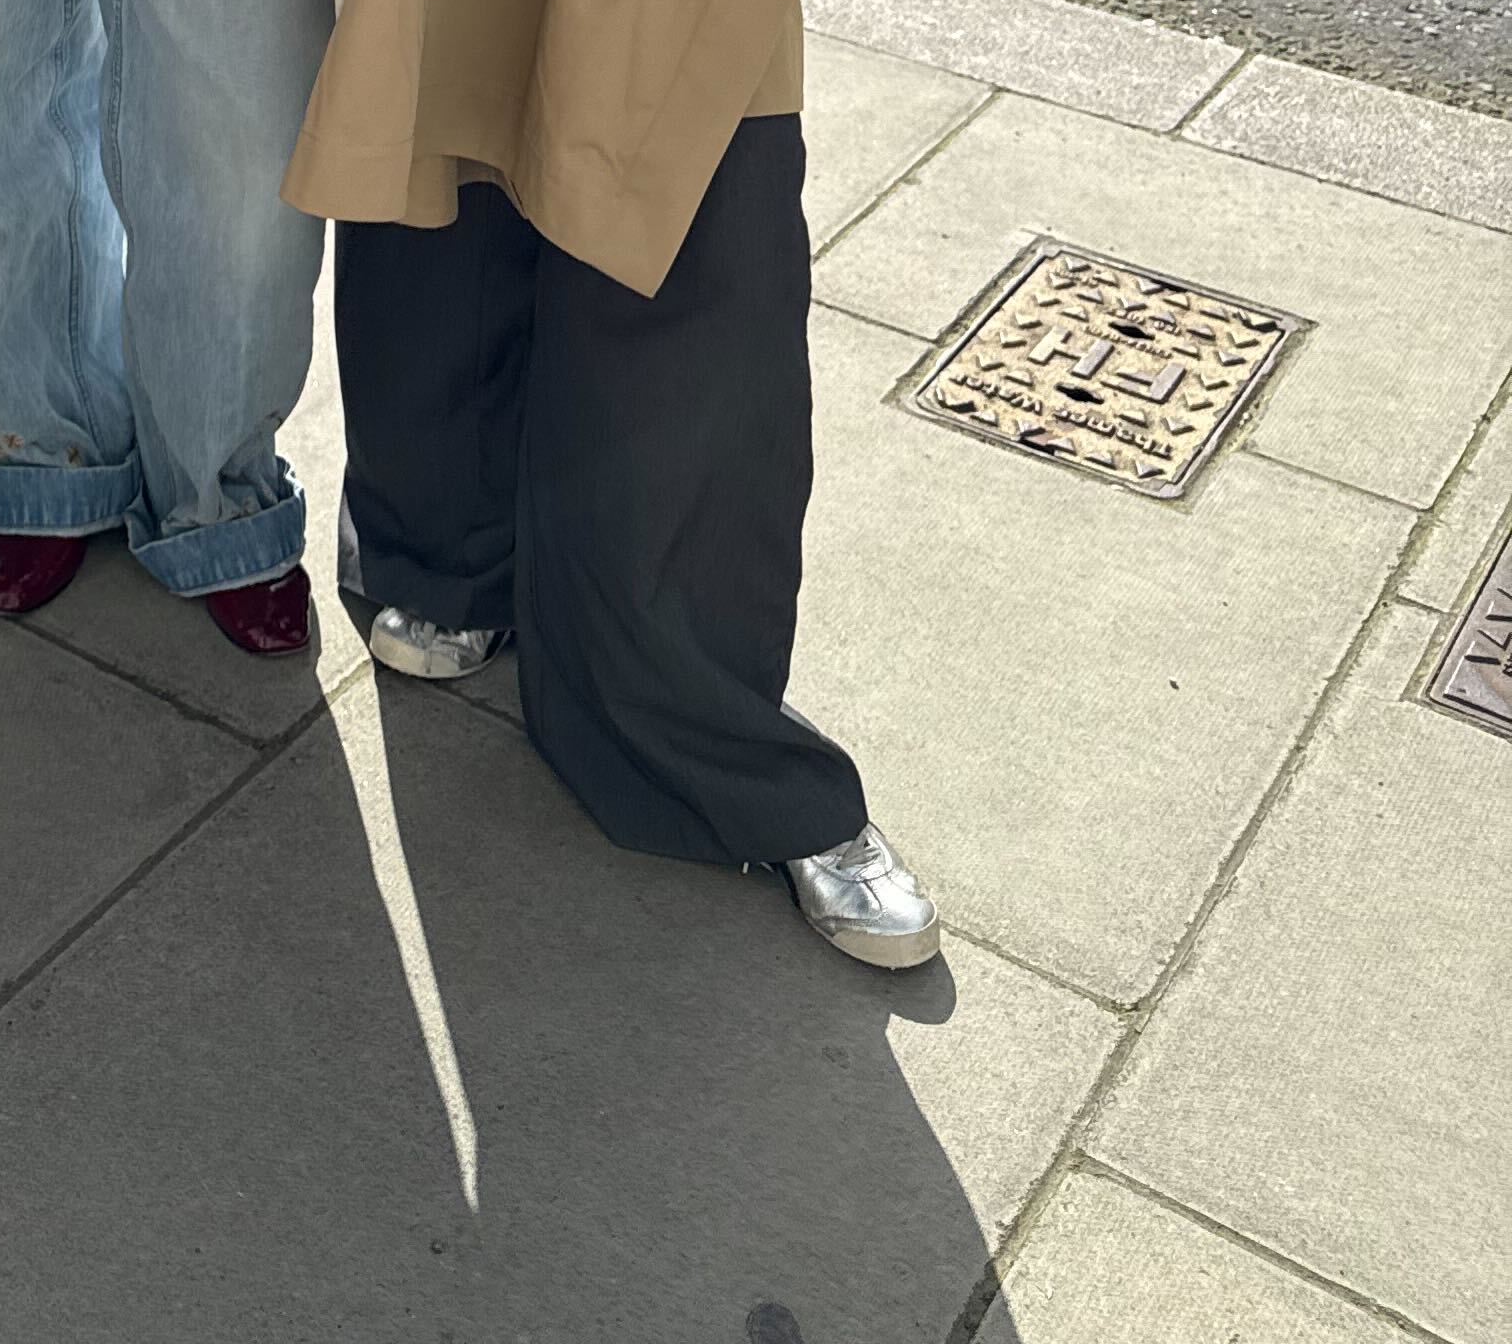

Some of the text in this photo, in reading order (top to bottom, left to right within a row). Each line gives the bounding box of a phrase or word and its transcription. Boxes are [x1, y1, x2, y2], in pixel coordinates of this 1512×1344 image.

[1026, 326, 1188, 405] FH
[944, 374, 1172, 463] Thames Water
